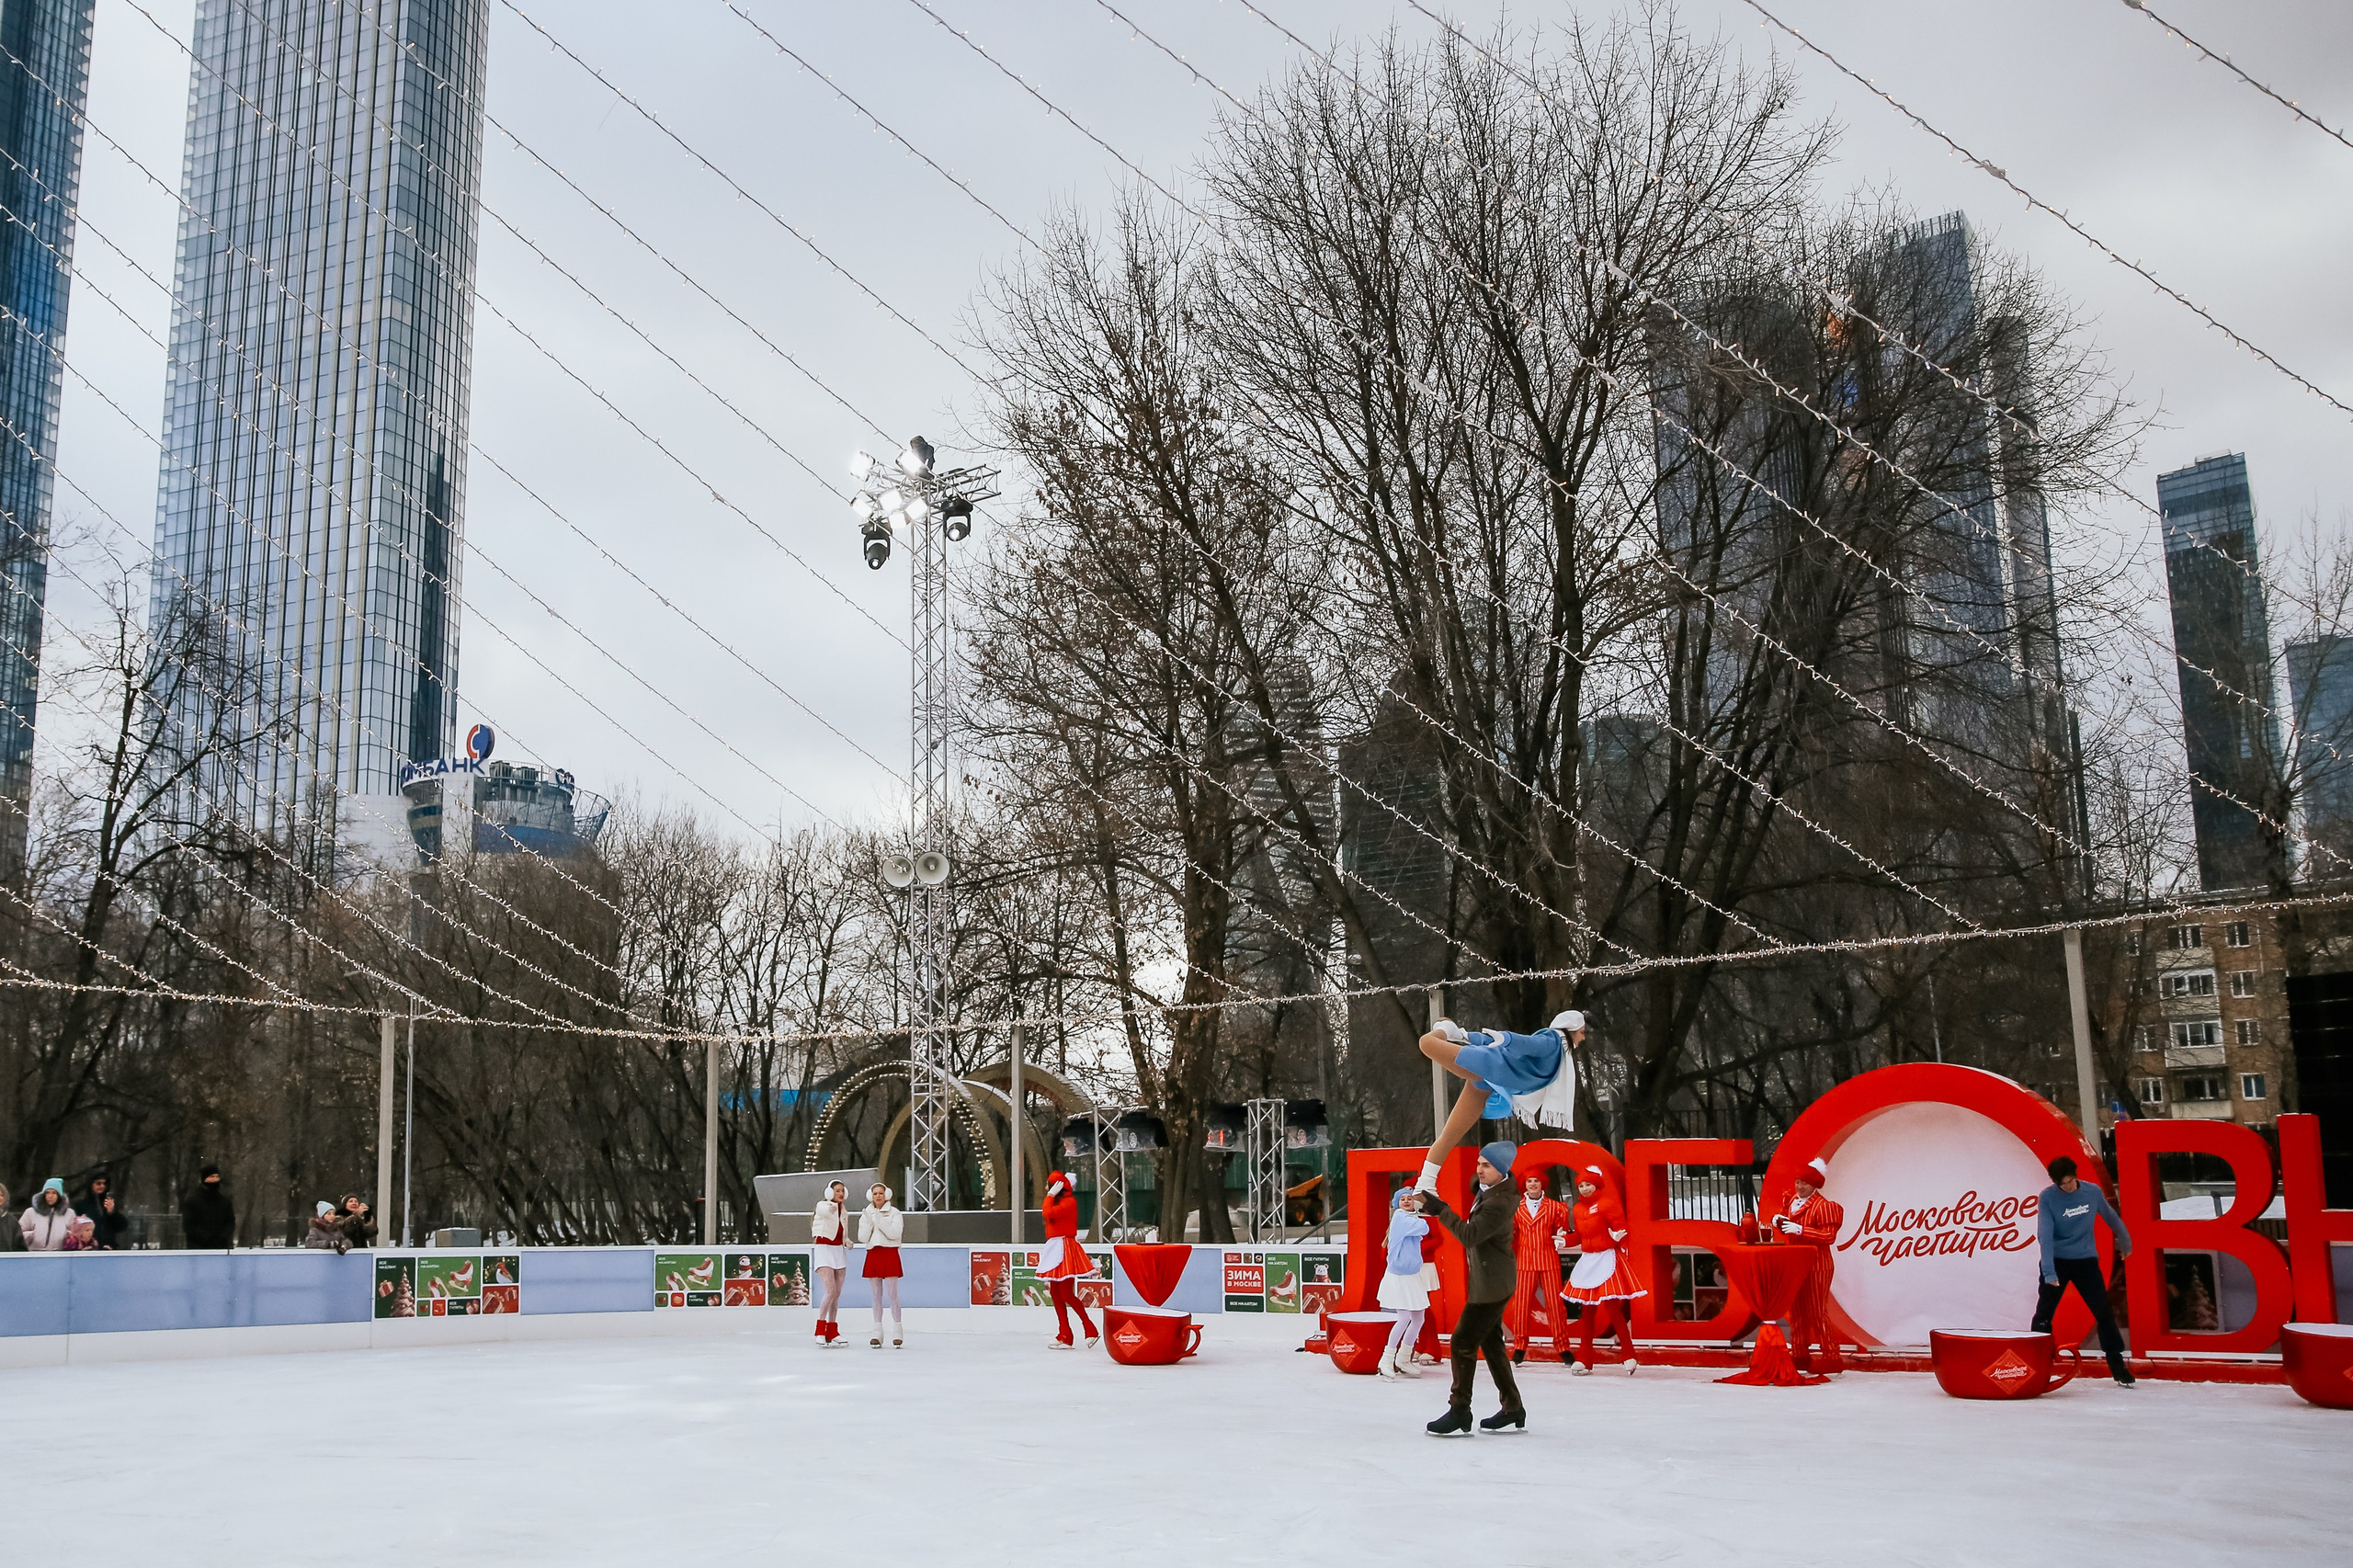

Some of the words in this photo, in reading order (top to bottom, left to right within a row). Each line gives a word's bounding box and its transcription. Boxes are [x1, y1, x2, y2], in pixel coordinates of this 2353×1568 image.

[1836, 1190, 2040, 1252] Московское
[1859, 1221, 2037, 1267] чаепитие
[1227, 1270, 1261, 1280] ЗИМА
